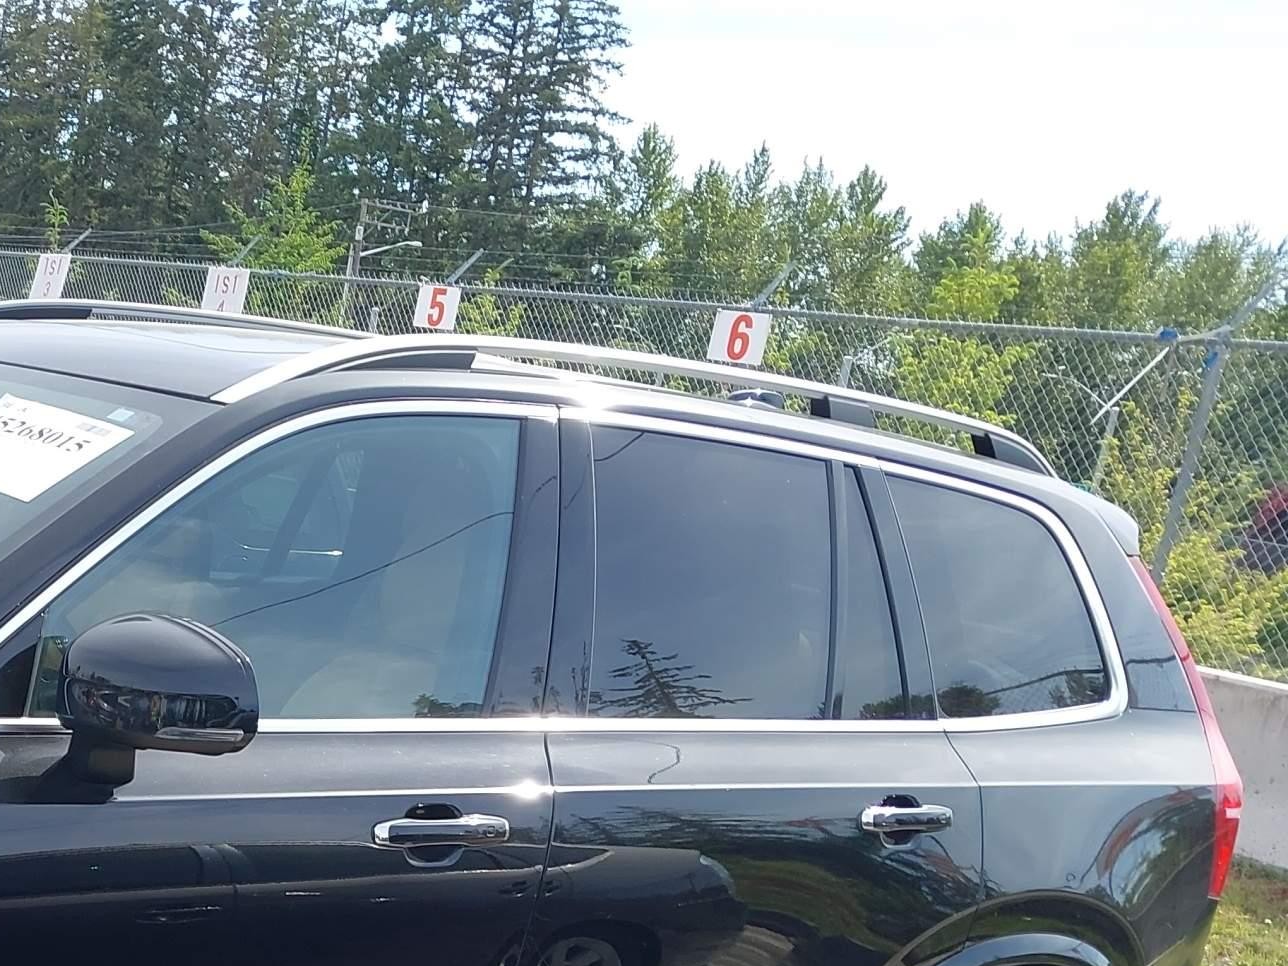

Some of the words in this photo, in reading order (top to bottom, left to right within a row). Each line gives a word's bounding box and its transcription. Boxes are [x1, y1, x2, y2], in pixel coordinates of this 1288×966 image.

[43, 281, 51, 297] 3
[426, 287, 448, 327] 5
[726, 314, 753, 361] 6
